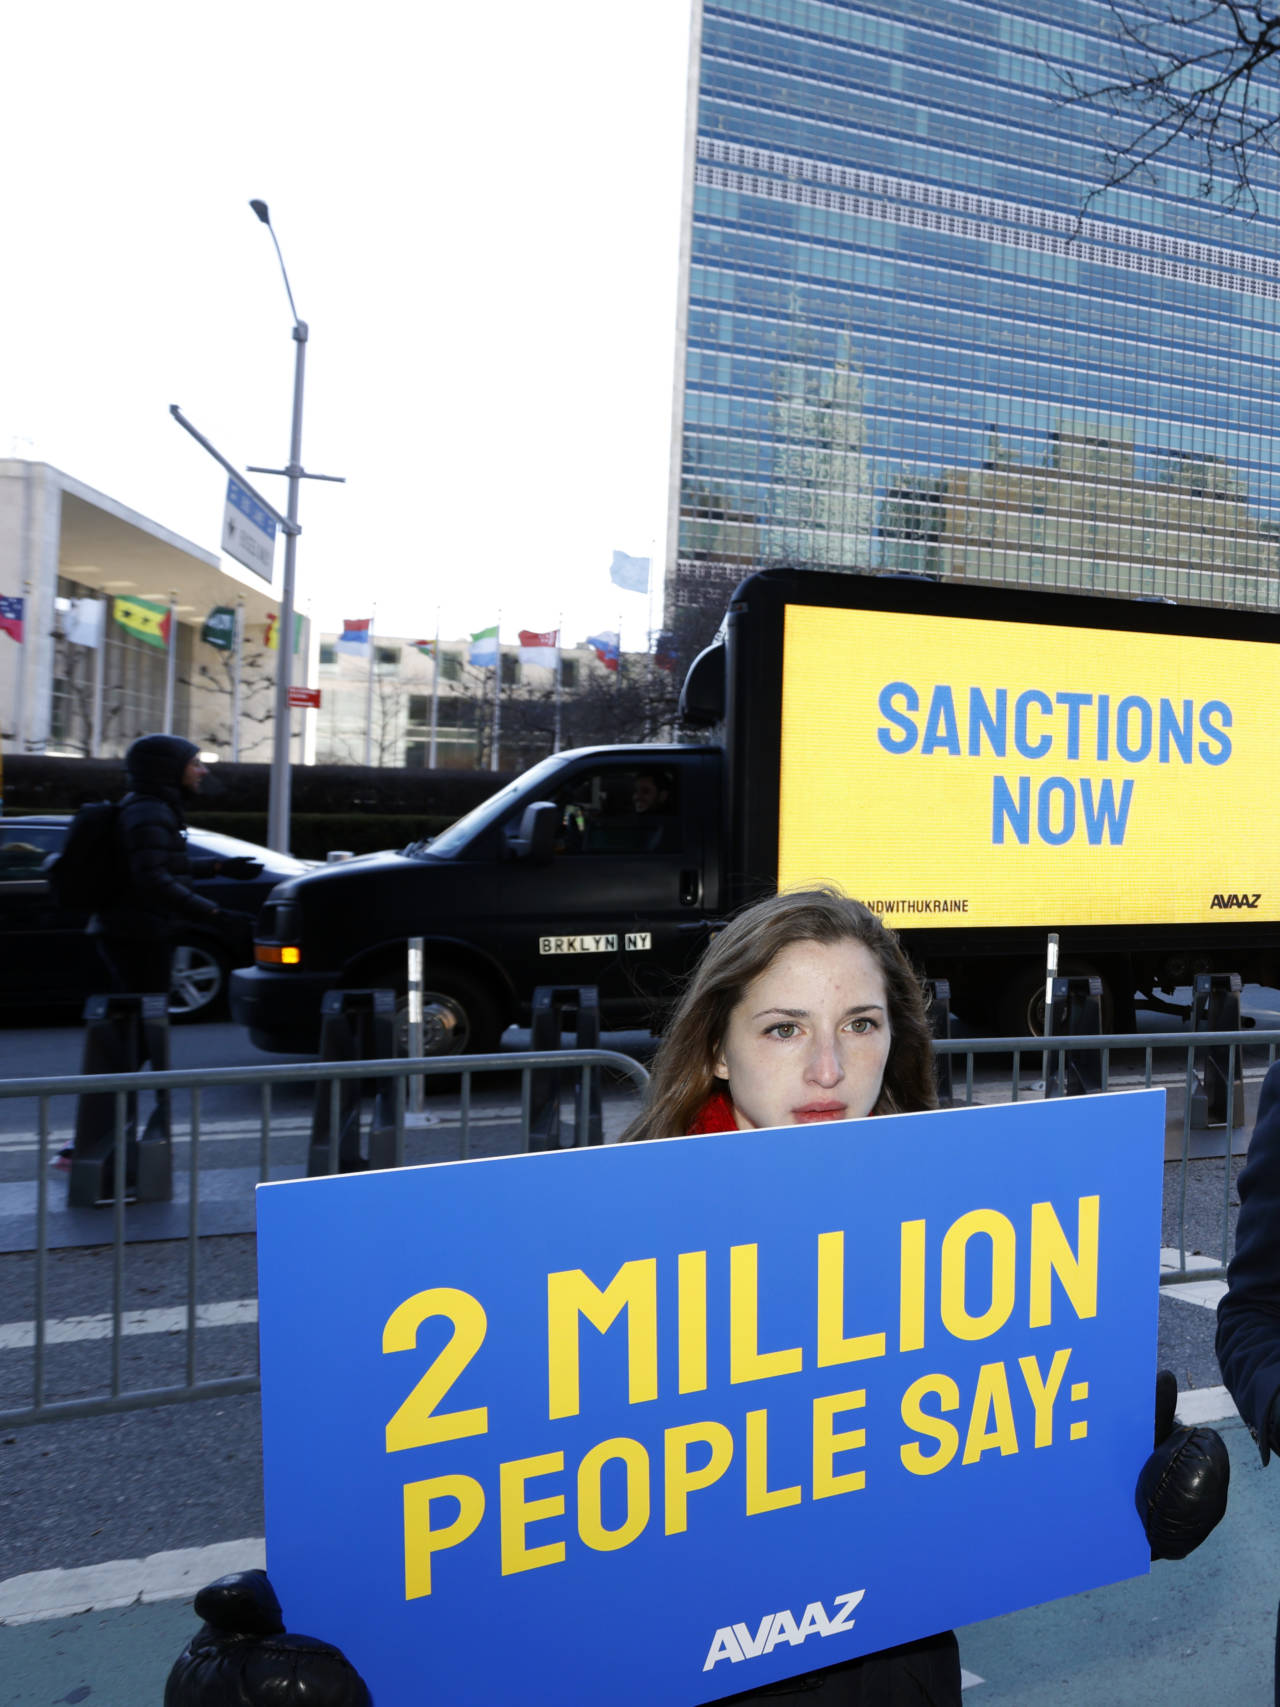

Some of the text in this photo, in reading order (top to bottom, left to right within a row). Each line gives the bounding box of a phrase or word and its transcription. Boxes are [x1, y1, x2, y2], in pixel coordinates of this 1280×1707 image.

[877, 682, 1233, 767] SANCTIONS
[992, 775, 1135, 846] NOW
[860, 899, 969, 913] NDWITHUKRAINE
[1209, 893, 1262, 910] AVAAZ
[542, 934, 648, 953] BRKLYN NY
[382, 1195, 1100, 1453] 2 MILLION
[403, 1348, 1090, 1601] PEOPLE SAY:
[702, 1588, 866, 1672] AVAAZ
